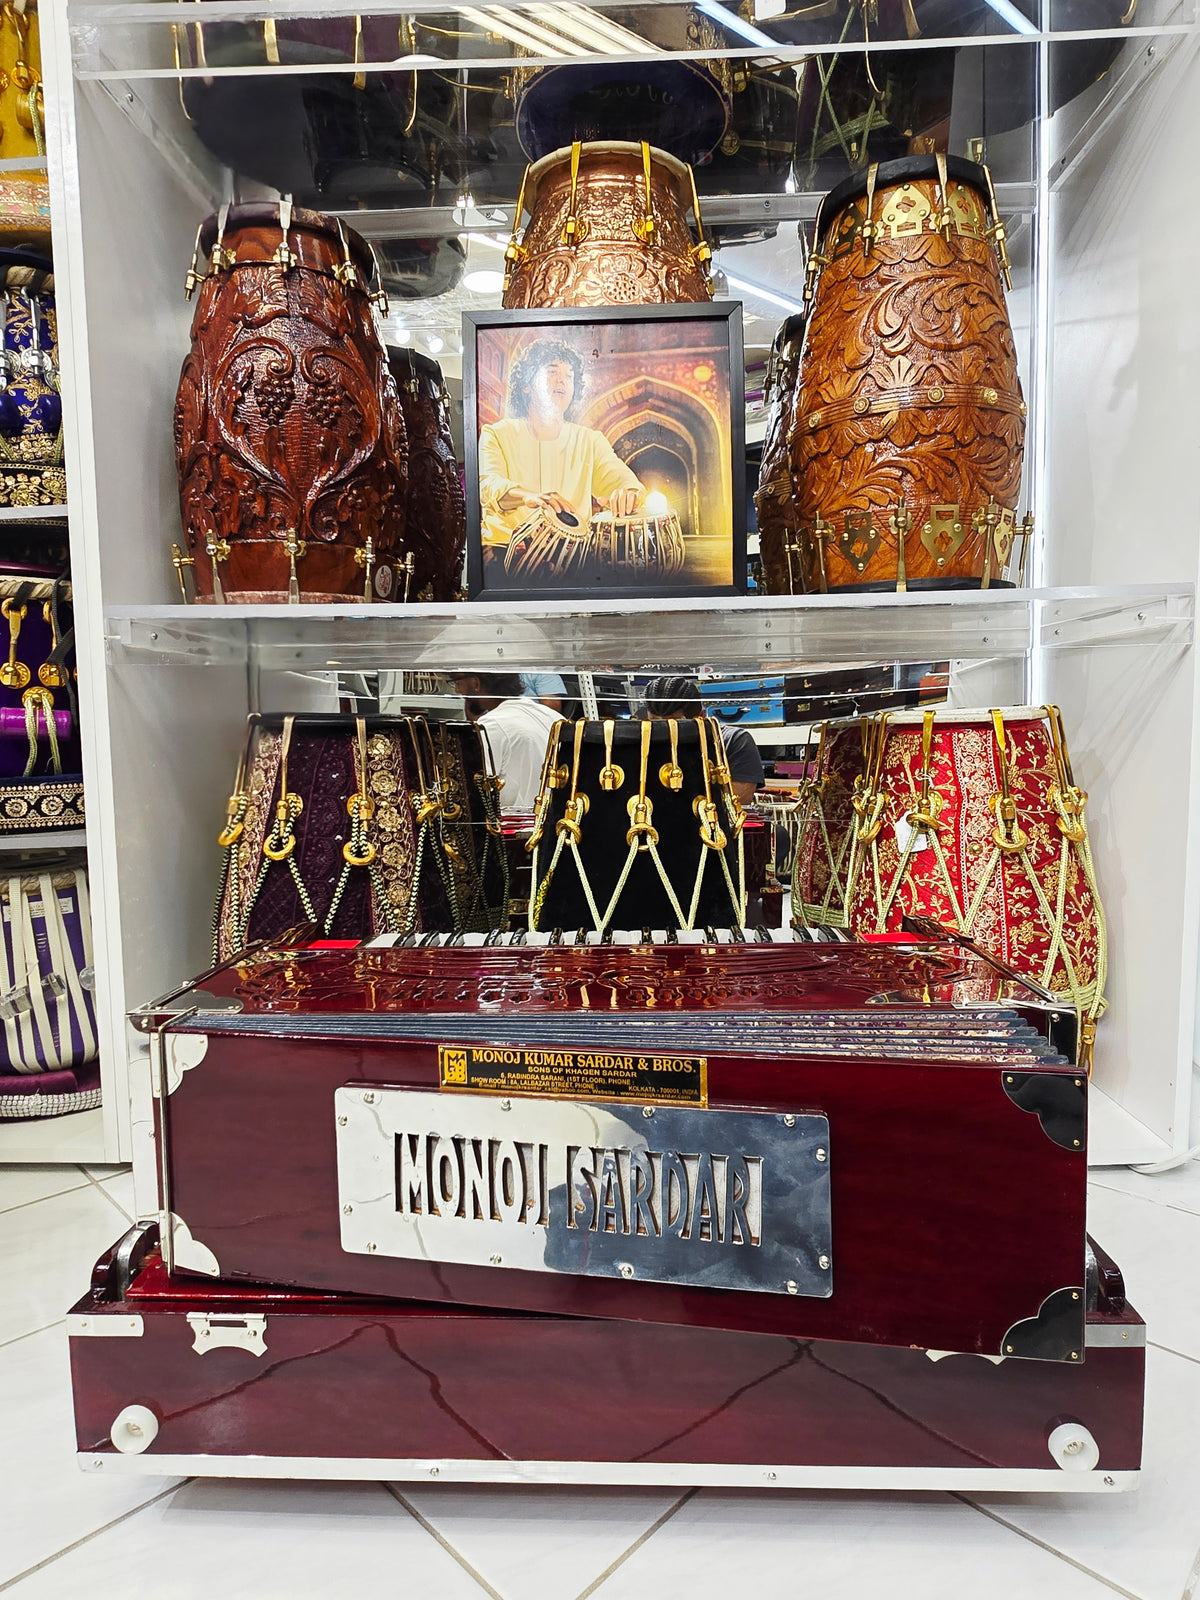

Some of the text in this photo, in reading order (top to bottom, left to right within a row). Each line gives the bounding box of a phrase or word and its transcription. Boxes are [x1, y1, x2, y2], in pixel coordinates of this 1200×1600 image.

[472, 1049, 696, 1073] MONOJ KUMAR SARDAR & BROS.
[508, 1072, 540, 1080] RABINDRA
[528, 1066, 550, 1074] SONS
[566, 1068, 600, 1076] KHAGEN
[602, 1070, 637, 1078] SARDAR
[394, 1131, 764, 1247] MONOJ SARDAR
